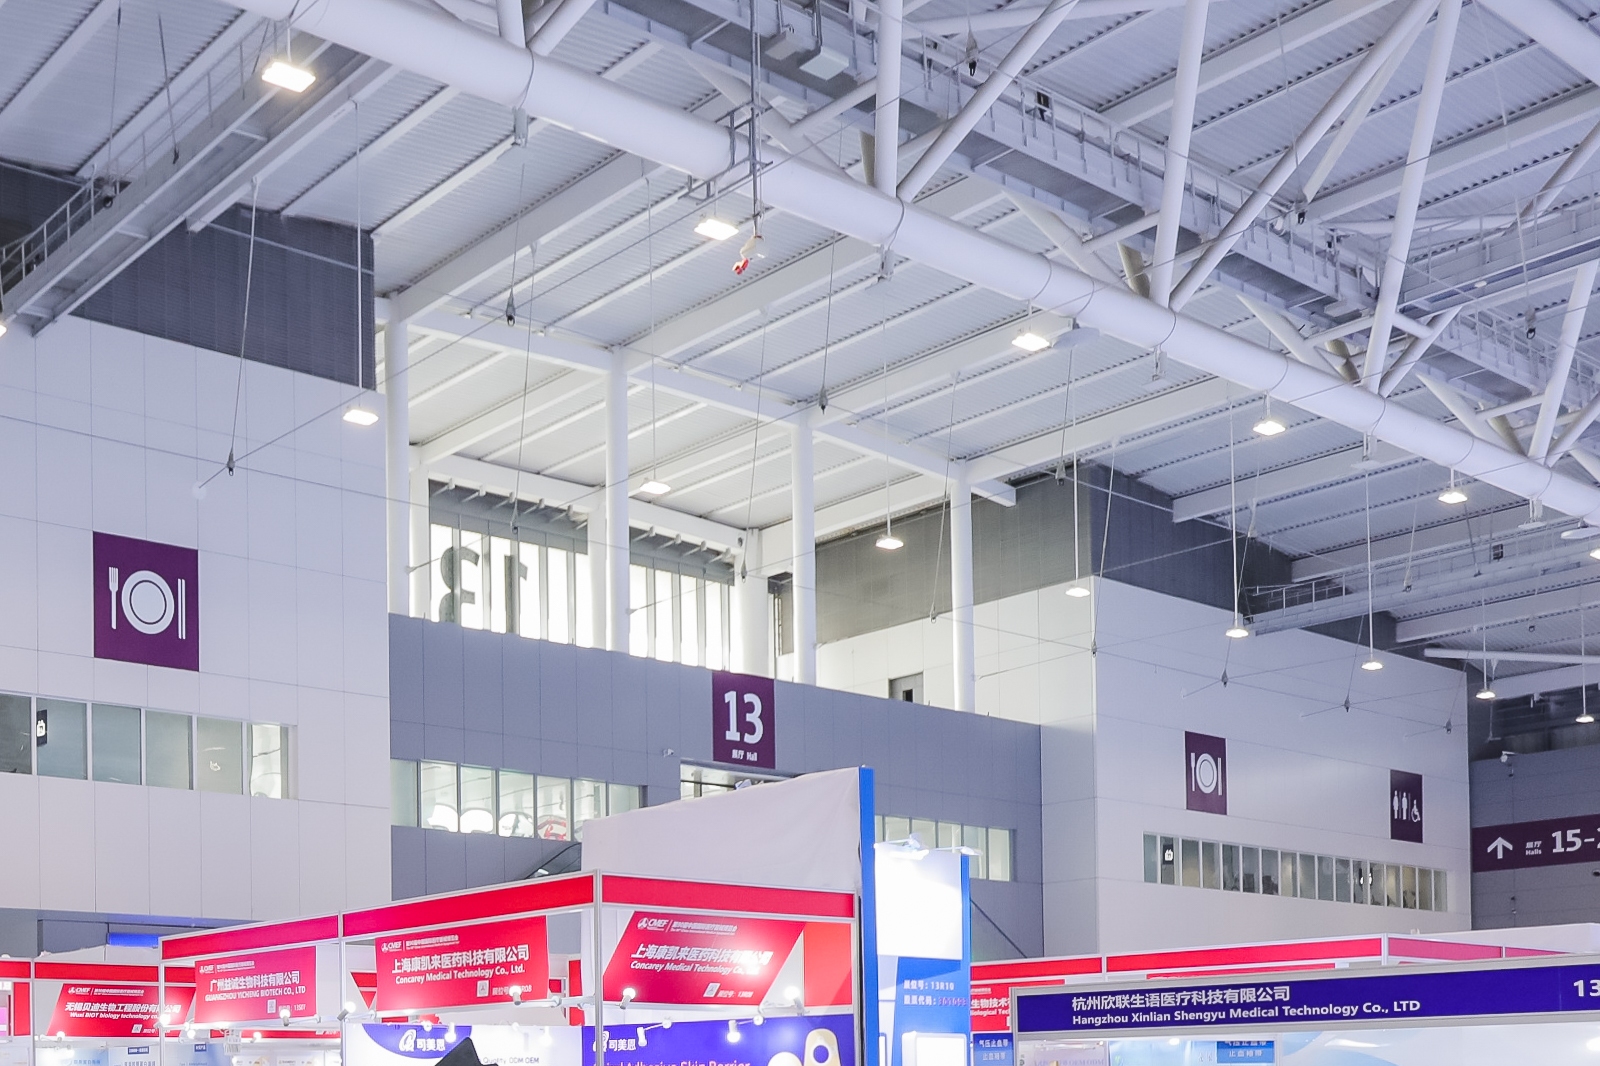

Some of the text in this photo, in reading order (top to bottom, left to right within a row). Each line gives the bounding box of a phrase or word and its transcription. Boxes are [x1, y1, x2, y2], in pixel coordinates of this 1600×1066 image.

[724, 690, 764, 744] 13
[746, 752, 758, 761] Hall
[395, 973, 425, 985] Concarey
[425, 970, 452, 982] Medical
[453, 967, 495, 980] Technology
[510, 963, 526, 973] Ltd.
[630, 960, 666, 972] Concarey
[664, 962, 693, 972] Medical
[693, 963, 734, 976] Technology
[204, 991, 237, 1002] GUANGZHOU
[260, 987, 283, 997] BIOTECH
[295, 985, 306, 994] LTD
[930, 981, 955, 991] 13R10
[1071, 985, 1290, 1012] 杭州欣联生语医疗科技有限公司
[100, 1012, 120, 1020] biology
[120, 1013, 151, 1021] technology
[1072, 1000, 1421, 1026] Hangzhou Xinlian Shengyu Medical Technology Co., LTD
